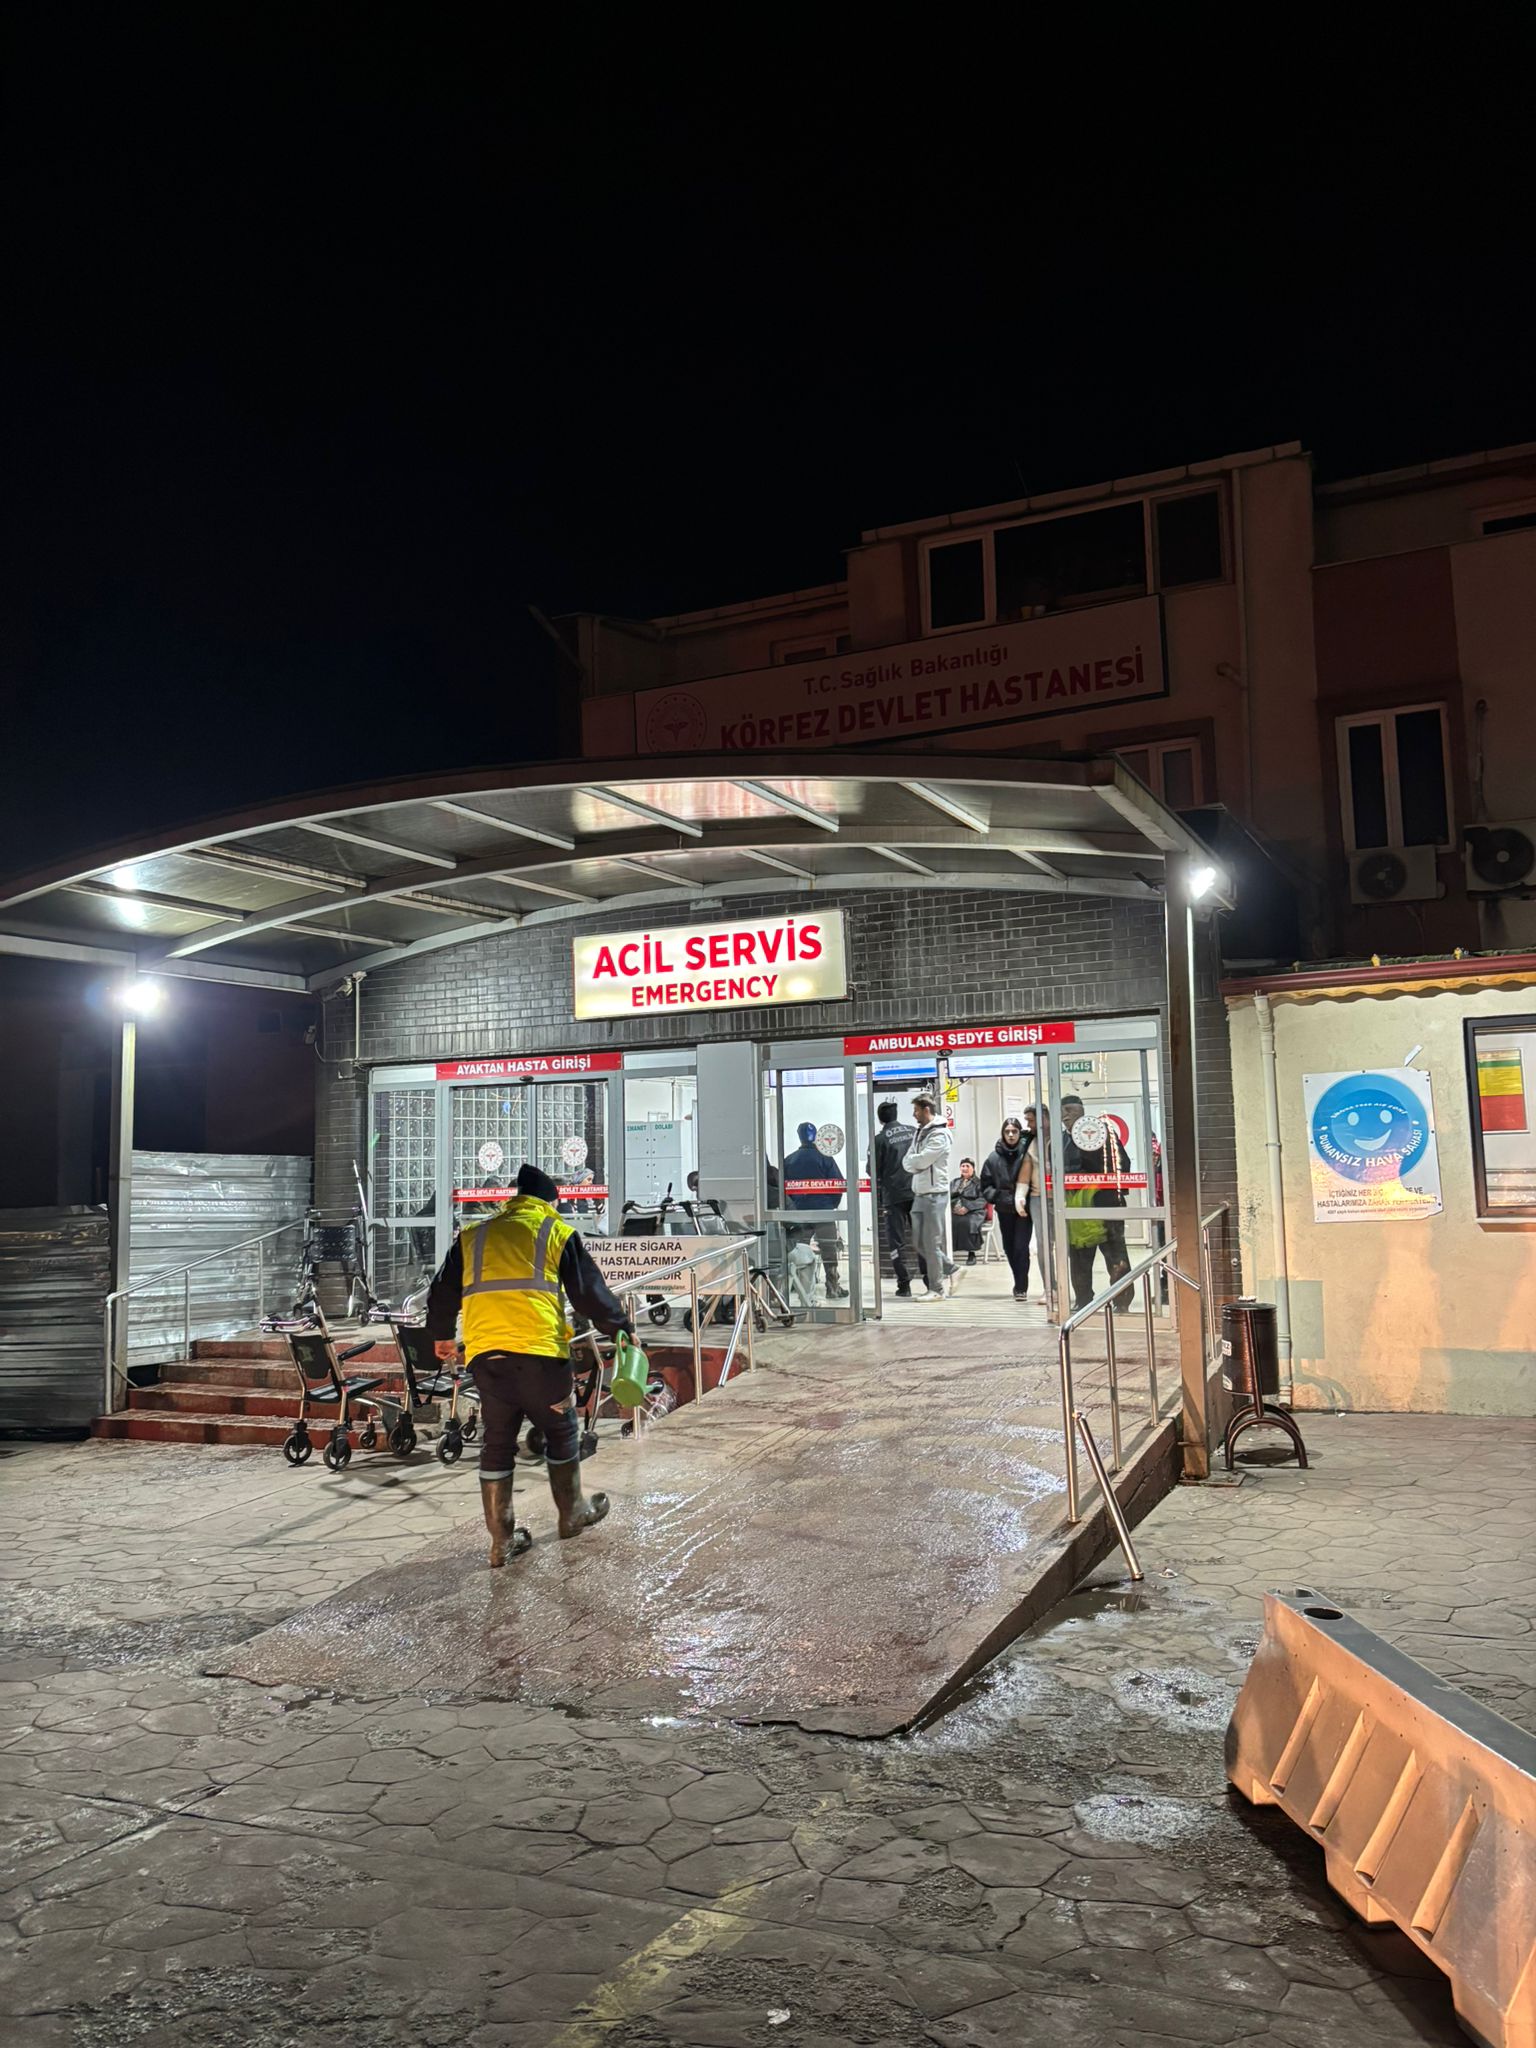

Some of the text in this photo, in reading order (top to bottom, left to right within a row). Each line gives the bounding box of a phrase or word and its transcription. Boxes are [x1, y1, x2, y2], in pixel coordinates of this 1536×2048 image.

[803, 645, 1009, 695] T.C. Sağlık Bakanlığı
[720, 645, 1145, 750] KÖRFEZ DEVLET HASTANESİ
[592, 919, 822, 979] ACİL SERVİS
[631, 974, 779, 1007] EMERGENCY
[868, 1025, 1043, 1051] AMBULANS SEDYE GİRİŞİ
[456, 1055, 592, 1076] AYAKTAN HASTA GİRİŞİ
[1319, 1129, 1423, 1167] DUMANSIZ HAVA SAHASI
[614, 1242, 637, 1252] HER
[640, 1240, 682, 1252] SİGARA
